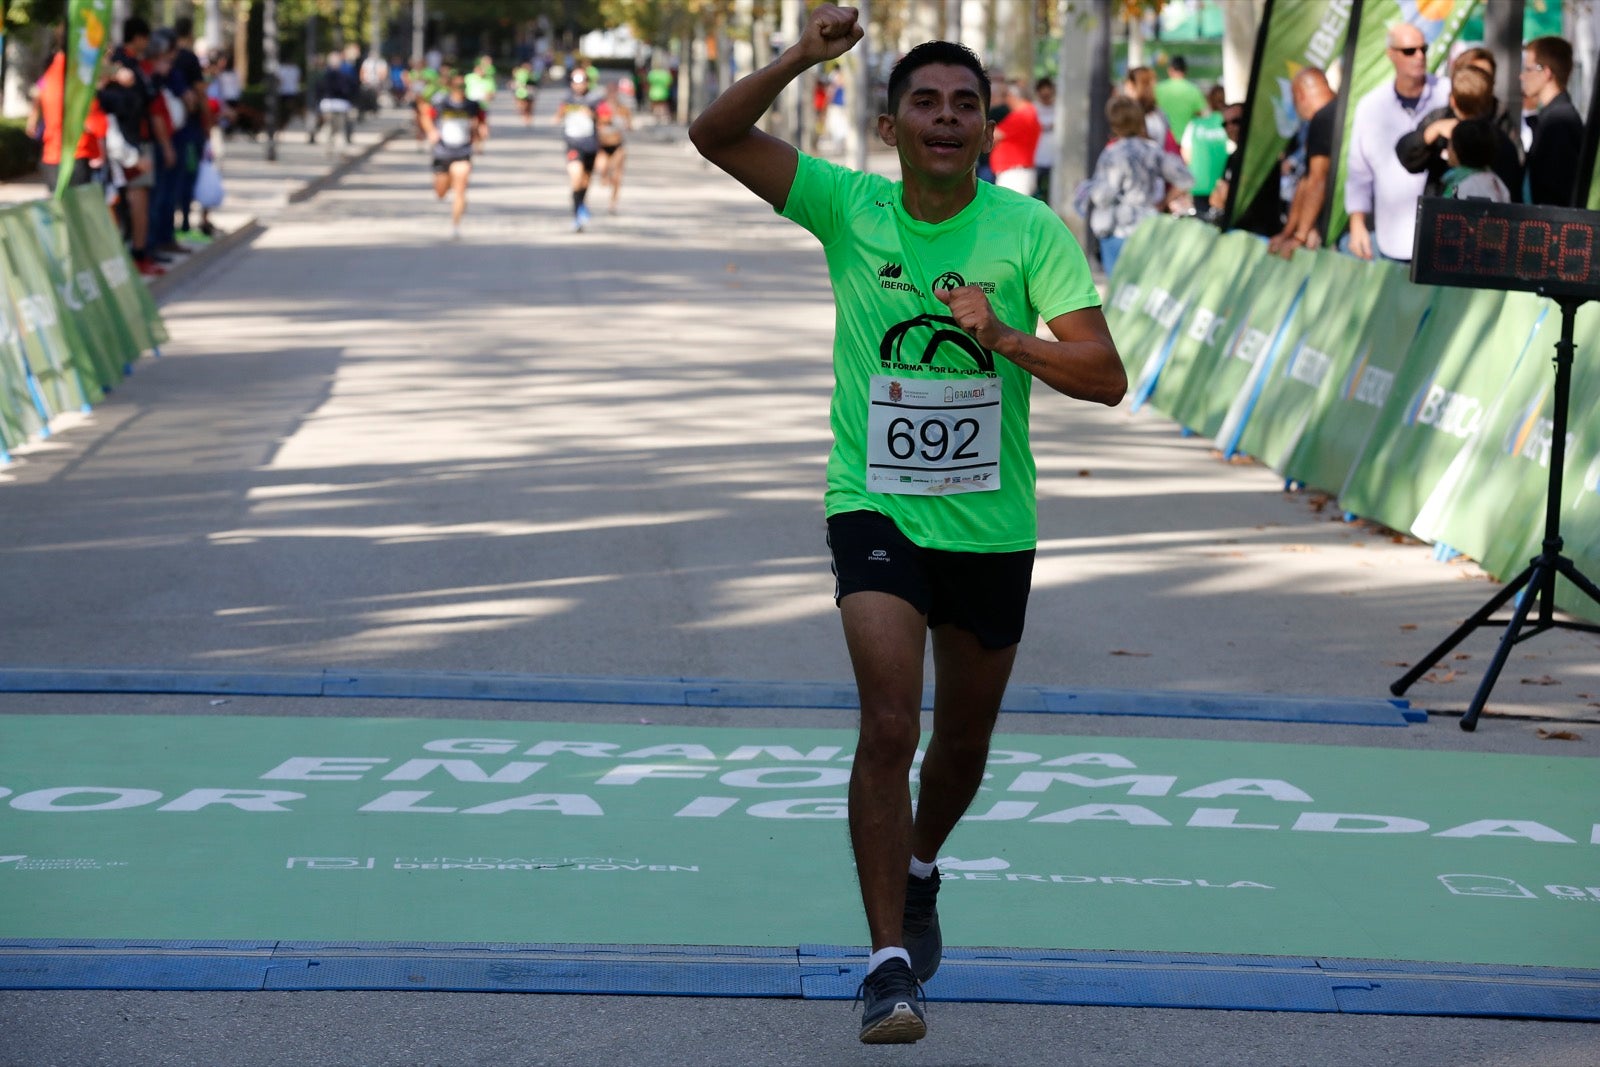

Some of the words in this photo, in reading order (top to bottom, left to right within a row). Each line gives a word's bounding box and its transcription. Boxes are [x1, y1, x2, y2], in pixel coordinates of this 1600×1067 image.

[893, 363, 923, 371] FORMA
[888, 417, 980, 461] 692
[259, 756, 549, 783] EN
[594, 764, 1315, 802] FOMA
[0, 786, 306, 812] OR
[357, 791, 605, 816] LA
[572, 863, 700, 872] JOVEN
